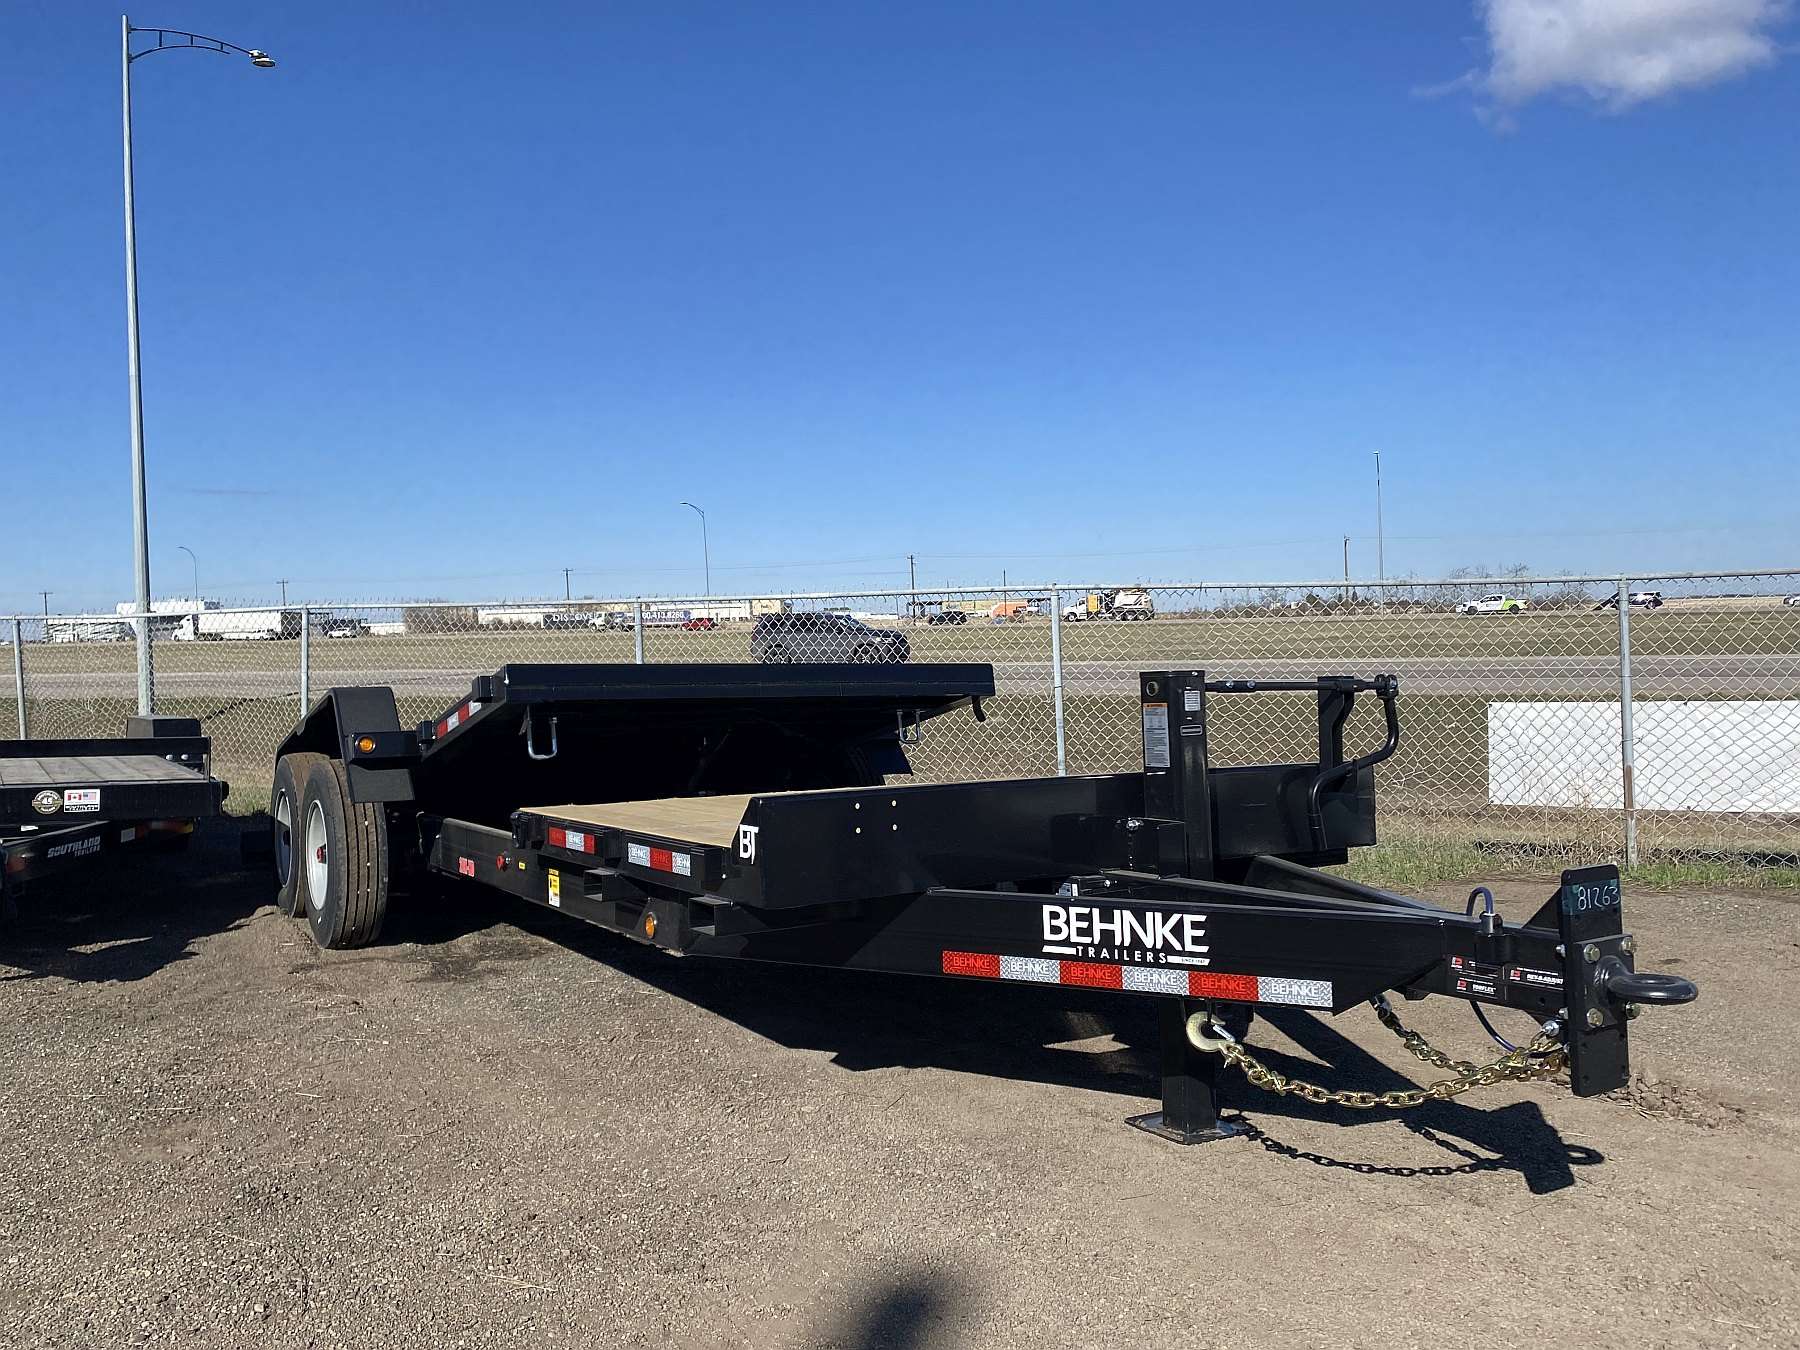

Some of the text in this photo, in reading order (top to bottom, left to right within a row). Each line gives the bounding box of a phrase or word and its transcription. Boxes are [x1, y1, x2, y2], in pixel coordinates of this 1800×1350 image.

[47, 835, 101, 858] SOUTHLAND
[739, 824, 759, 864] BT
[1578, 886, 1620, 910] 81263
[1042, 904, 1210, 952] BEHNKE
[953, 956, 990, 968] BEHNKE
[1077, 946, 1168, 964] TRAILERS
[1010, 961, 1049, 974] BEHNKE
[1071, 967, 1111, 979] BEHNKE
[1134, 972, 1177, 985] BEHNKE
[1201, 977, 1246, 992] BEHNKE
[1271, 983, 1319, 997] BEHNKE
